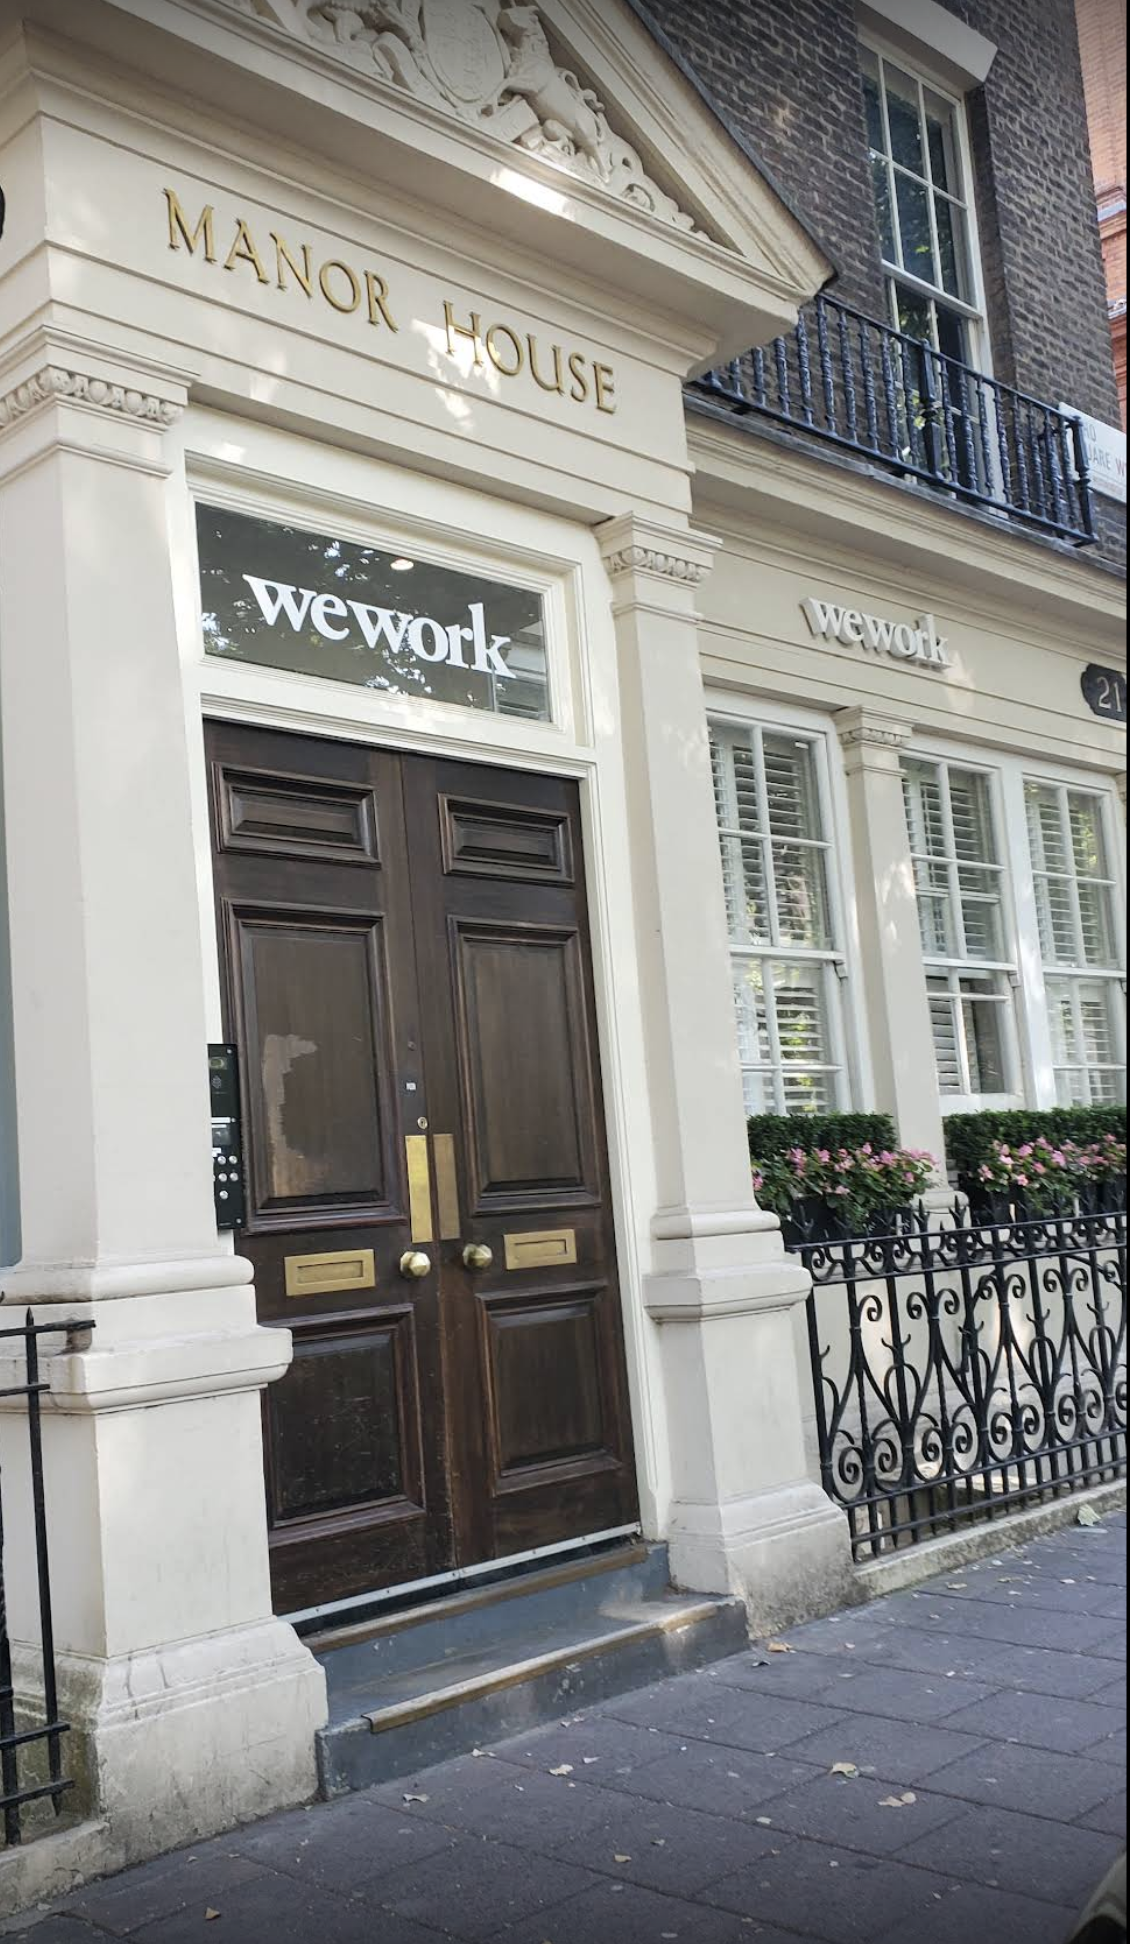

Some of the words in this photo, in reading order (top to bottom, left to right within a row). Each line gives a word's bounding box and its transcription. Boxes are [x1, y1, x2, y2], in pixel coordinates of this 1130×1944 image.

[163, 187, 399, 333] MANOR
[443, 300, 617, 414] HOUSE
[242, 574, 517, 679] wework
[801, 597, 952, 669] wework
[1096, 676, 1122, 713] 21
